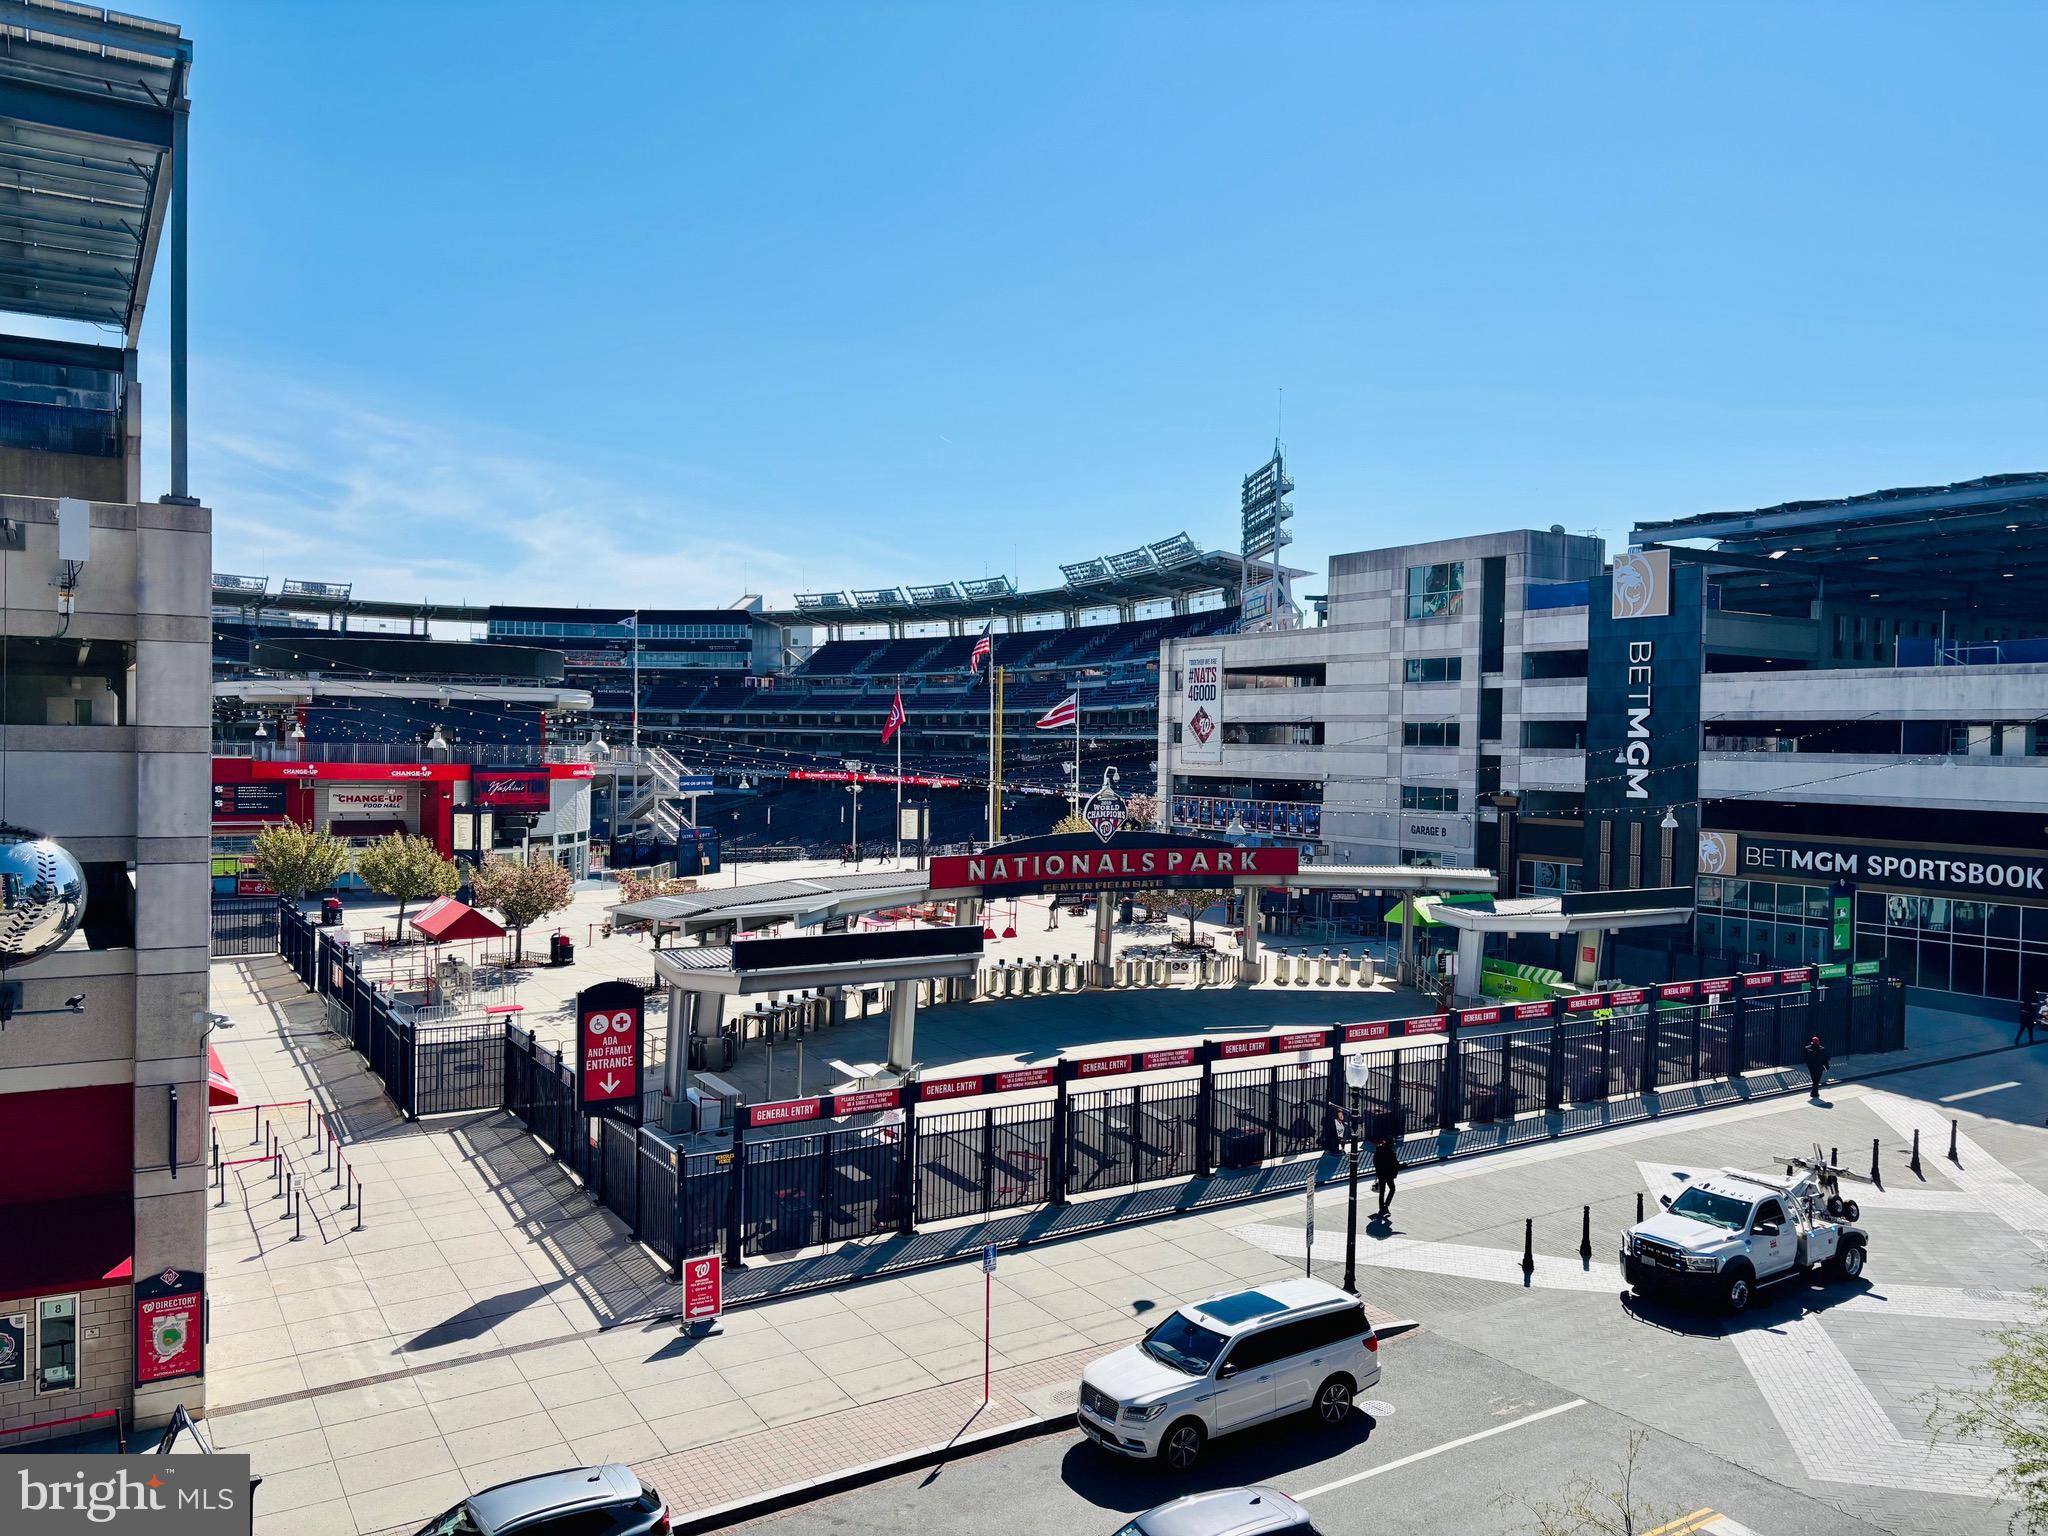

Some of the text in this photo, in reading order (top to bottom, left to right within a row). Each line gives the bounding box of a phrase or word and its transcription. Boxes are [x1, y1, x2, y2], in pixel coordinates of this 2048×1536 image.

[1189, 666, 1217, 683] #NATS
[1188, 684, 1216, 701] 4GOOD
[1626, 641, 1652, 799] BETMGM
[339, 795, 403, 803] CHANGE-UP
[1087, 811, 1126, 819] CHAMPIONS
[1411, 825, 1446, 836] GARAGE B
[968, 852, 1257, 881] NATIONALS PARK
[1746, 846, 2045, 890] BETMGM SPORTSBOOK
[1043, 879, 1163, 891] CENTER FIELD GATE
[1571, 1000, 1586, 1008] GENERAL
[1464, 1012, 1496, 1022] GENERAL ENTRY
[1350, 1026, 1385, 1037] GENERAL ENTRY
[603, 1036, 618, 1046] ADA
[588, 1045, 632, 1058] AND FAMILY
[1226, 1042, 1265, 1054] GENERAL ENTRY
[586, 1056, 633, 1070] ENTRANCE
[1083, 1060, 1127, 1072] GENERAL ENTRY
[926, 1081, 976, 1095] GENERAL ENTRY
[757, 1105, 814, 1120] GENERAL ENTRY
[156, 1296, 196, 1309] DIRECTORY
[54, 1305, 62, 1314] 8
